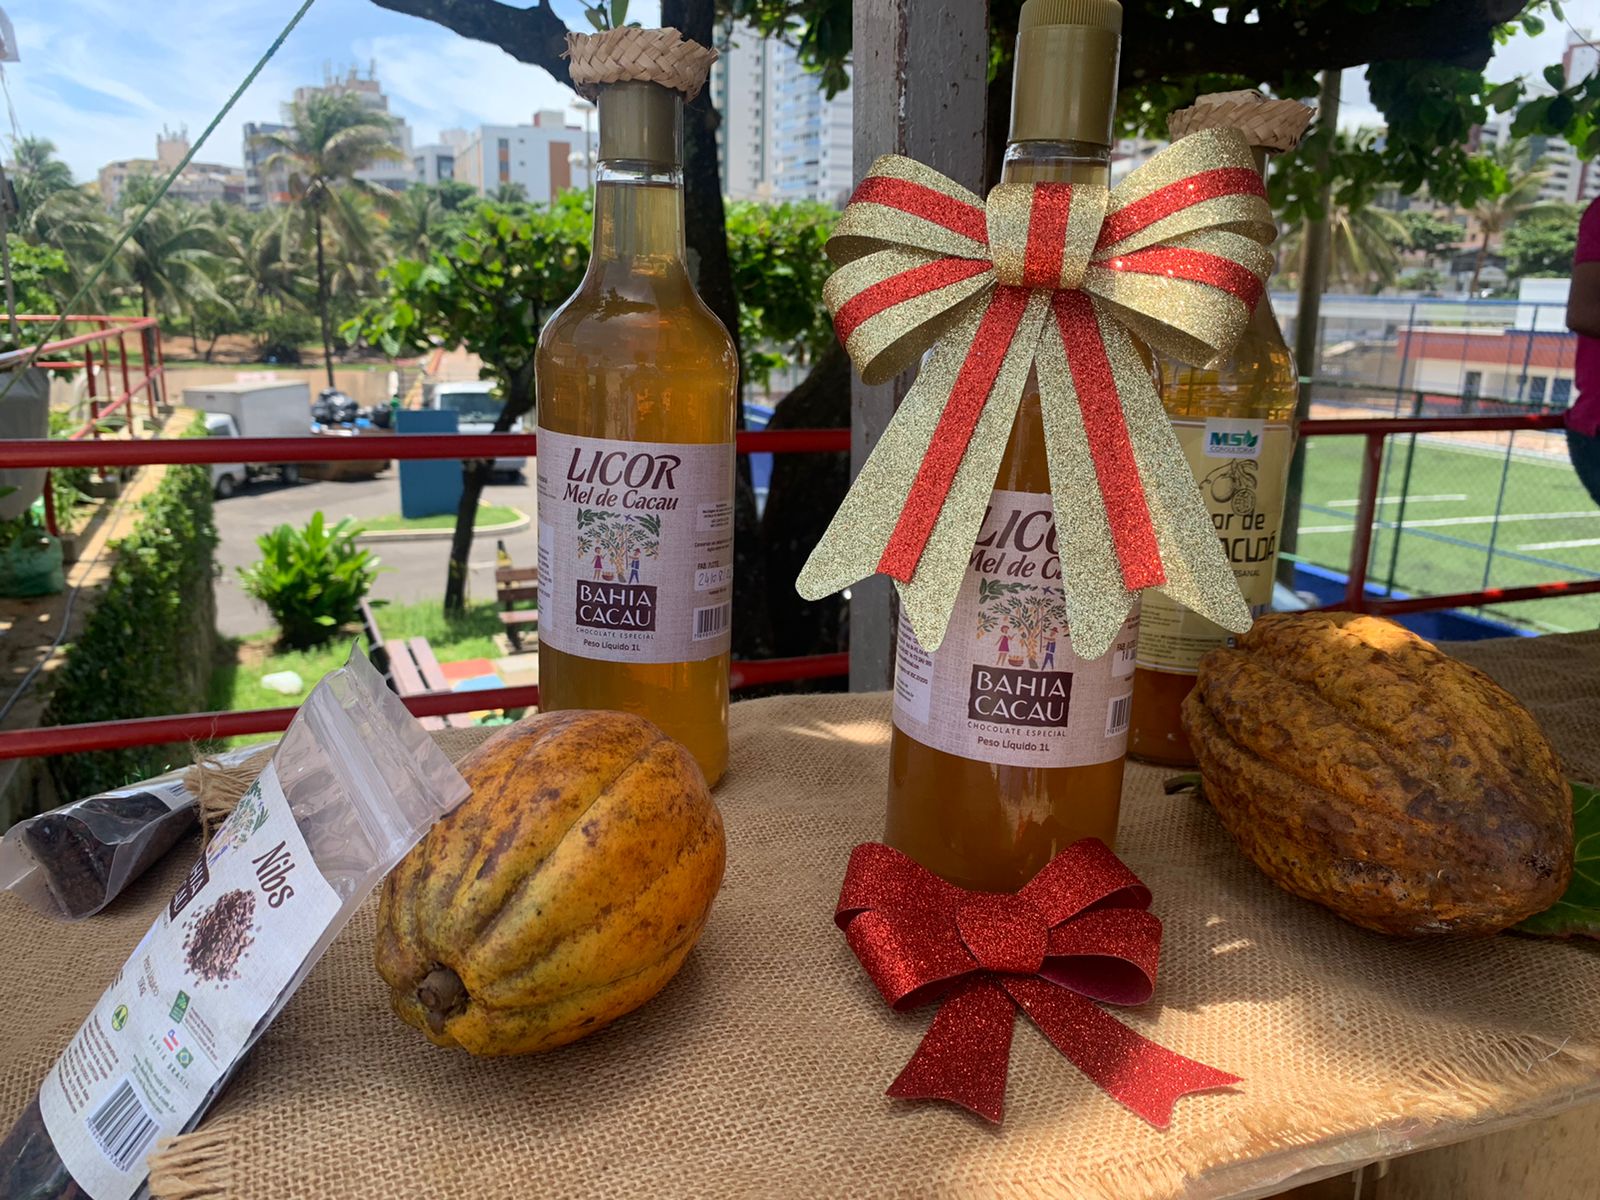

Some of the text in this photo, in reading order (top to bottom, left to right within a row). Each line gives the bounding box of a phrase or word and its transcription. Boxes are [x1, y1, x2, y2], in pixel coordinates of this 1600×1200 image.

[566, 447, 682, 490] LICOR
[562, 482, 593, 505] Mel
[595, 489, 617, 508] de
[622, 488, 679, 511] Cacau
[1242, 508, 1265, 530] de
[1006, 554, 1036, 578] de
[580, 584, 652, 607] BAHIA
[579, 605, 651, 627] CACAU
[575, 626, 655, 640] CHOCOLATE ESPECIAL
[583, 638, 641, 652] Peso Líquido 1L
[975, 671, 1067, 698] BAHIA
[974, 695, 1064, 722] CACAU
[967, 720, 1067, 738] CHOCOLATE ESPECIAL
[977, 736, 1051, 752] Peso Líquido 1L
[251, 840, 295, 909] Nibs
